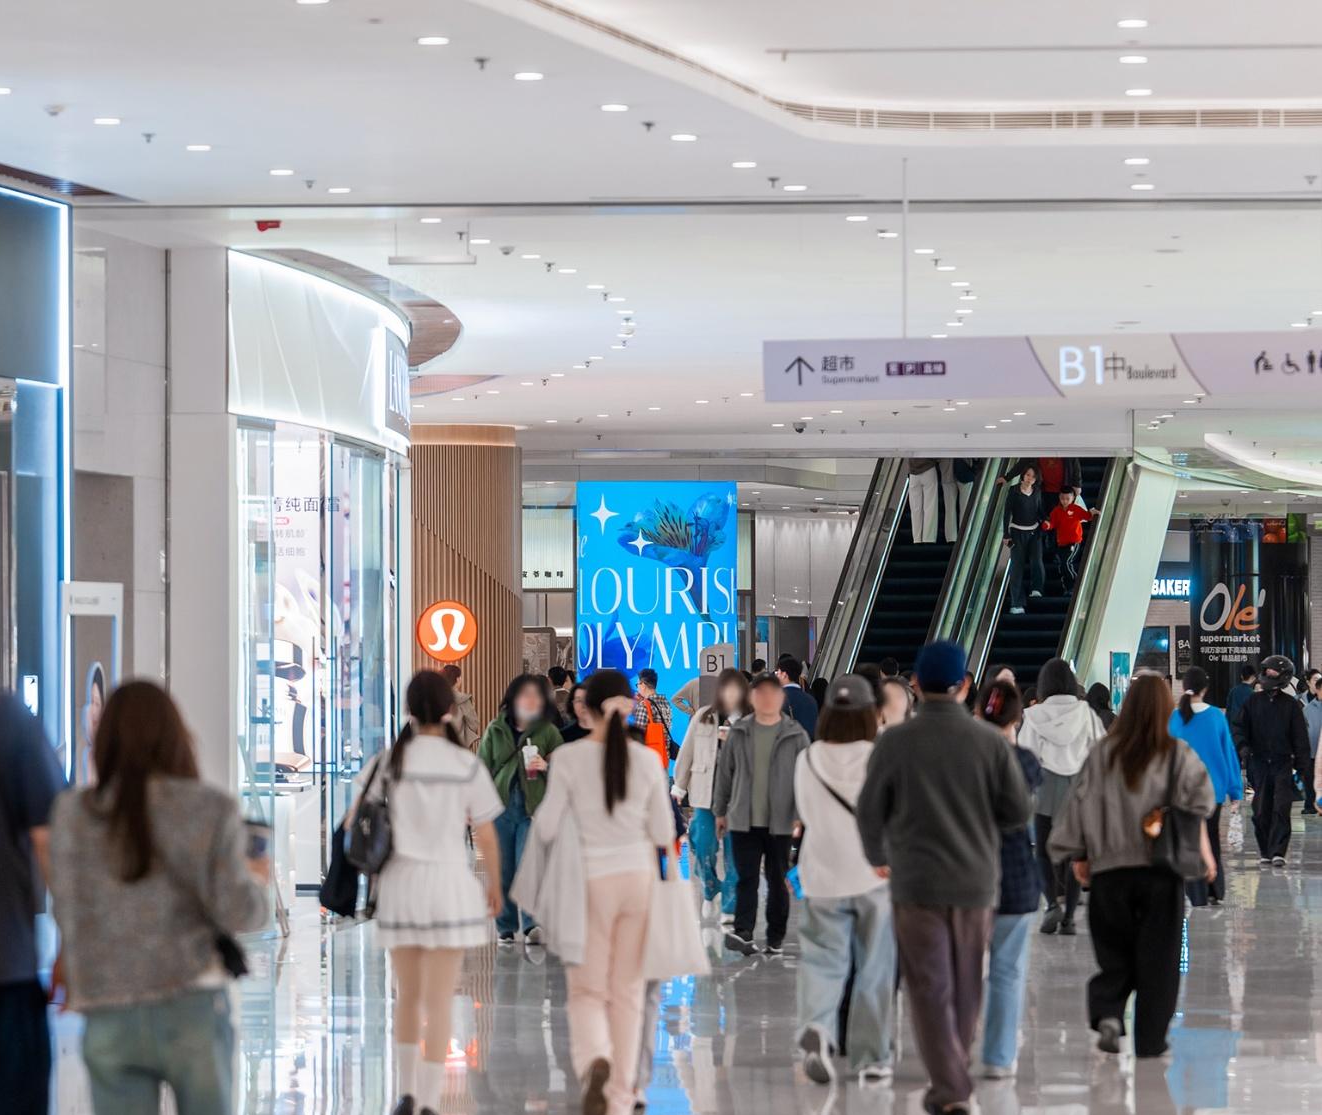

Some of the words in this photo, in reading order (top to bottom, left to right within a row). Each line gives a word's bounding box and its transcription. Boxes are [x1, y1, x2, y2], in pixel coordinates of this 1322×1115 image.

[821, 355, 855, 372] 超市
[1059, 345, 1103, 385] B1
[821, 374, 880, 385] Supermarket
[1200, 634, 1261, 645] supermarket
[707, 655, 726, 673] B1
